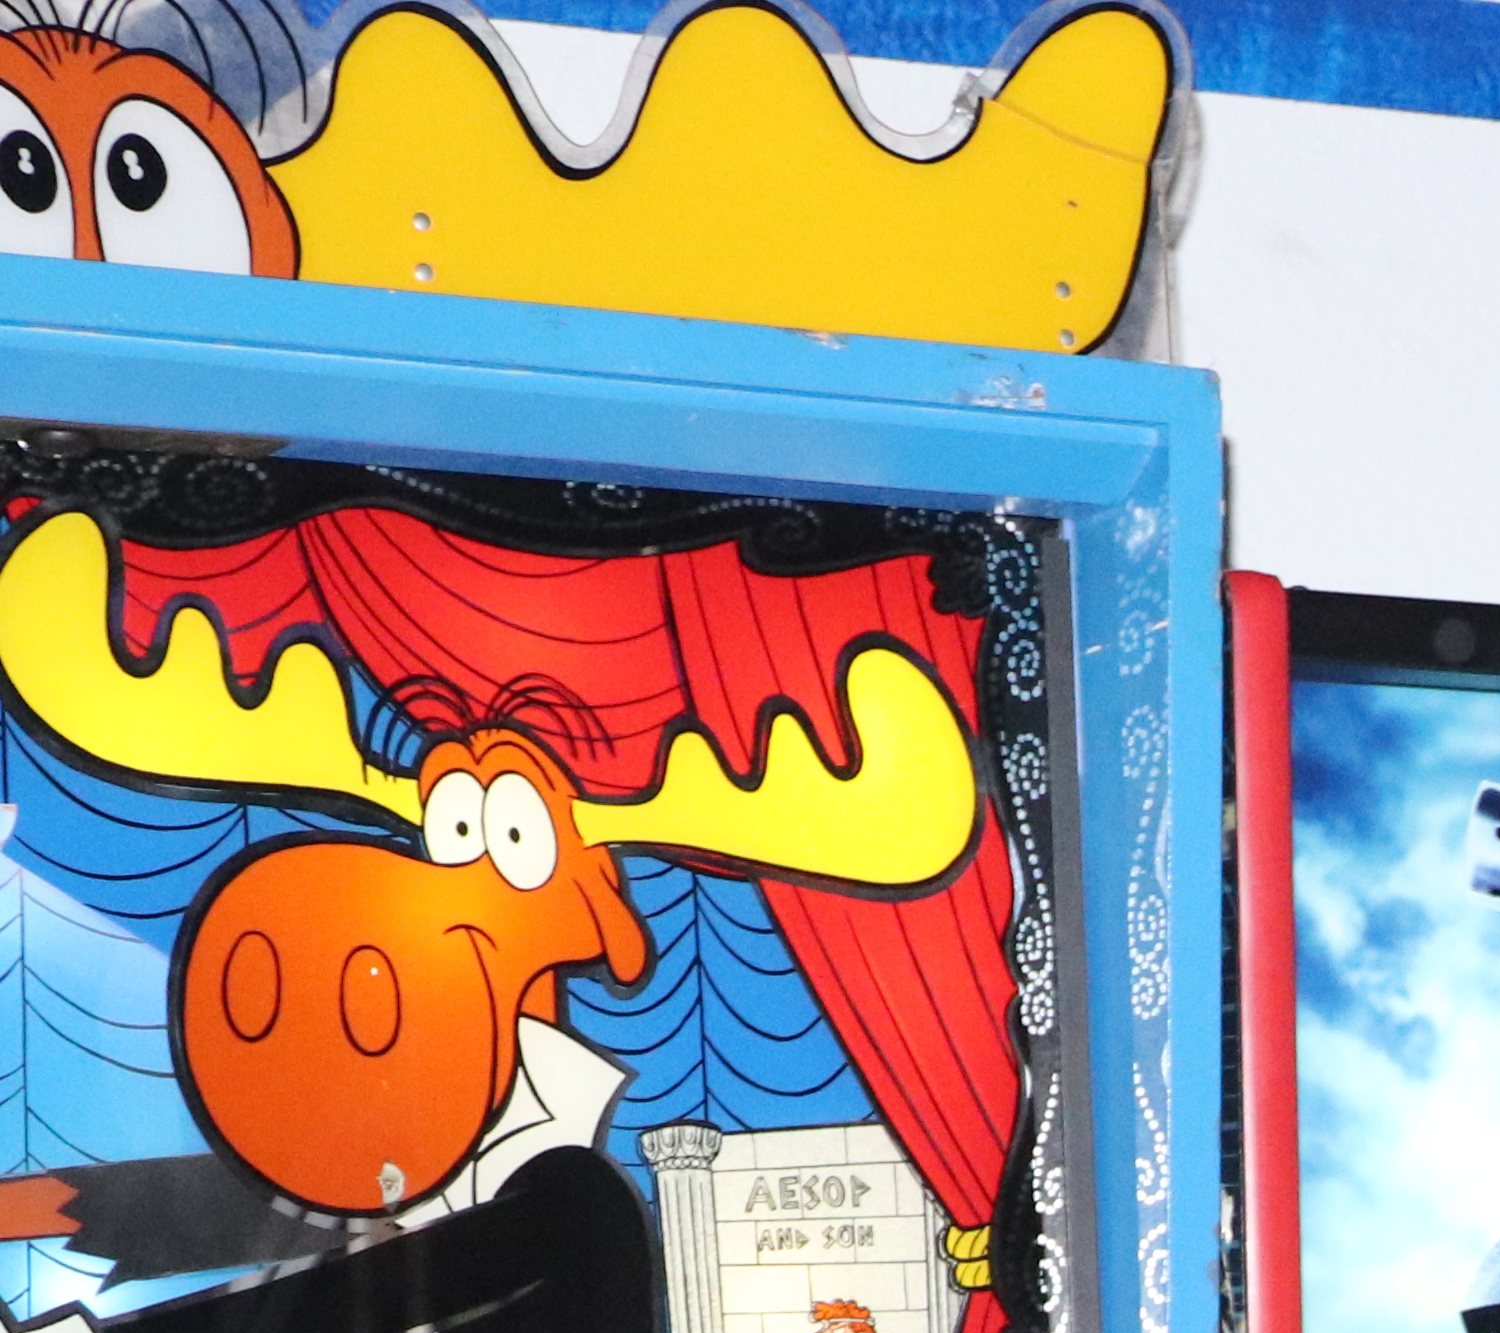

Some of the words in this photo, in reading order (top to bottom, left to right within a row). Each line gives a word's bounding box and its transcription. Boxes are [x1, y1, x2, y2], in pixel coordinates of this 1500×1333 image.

[744, 1172, 872, 1216] AESOP
[755, 1226, 811, 1254] AND
[822, 1222, 876, 1252] SON
